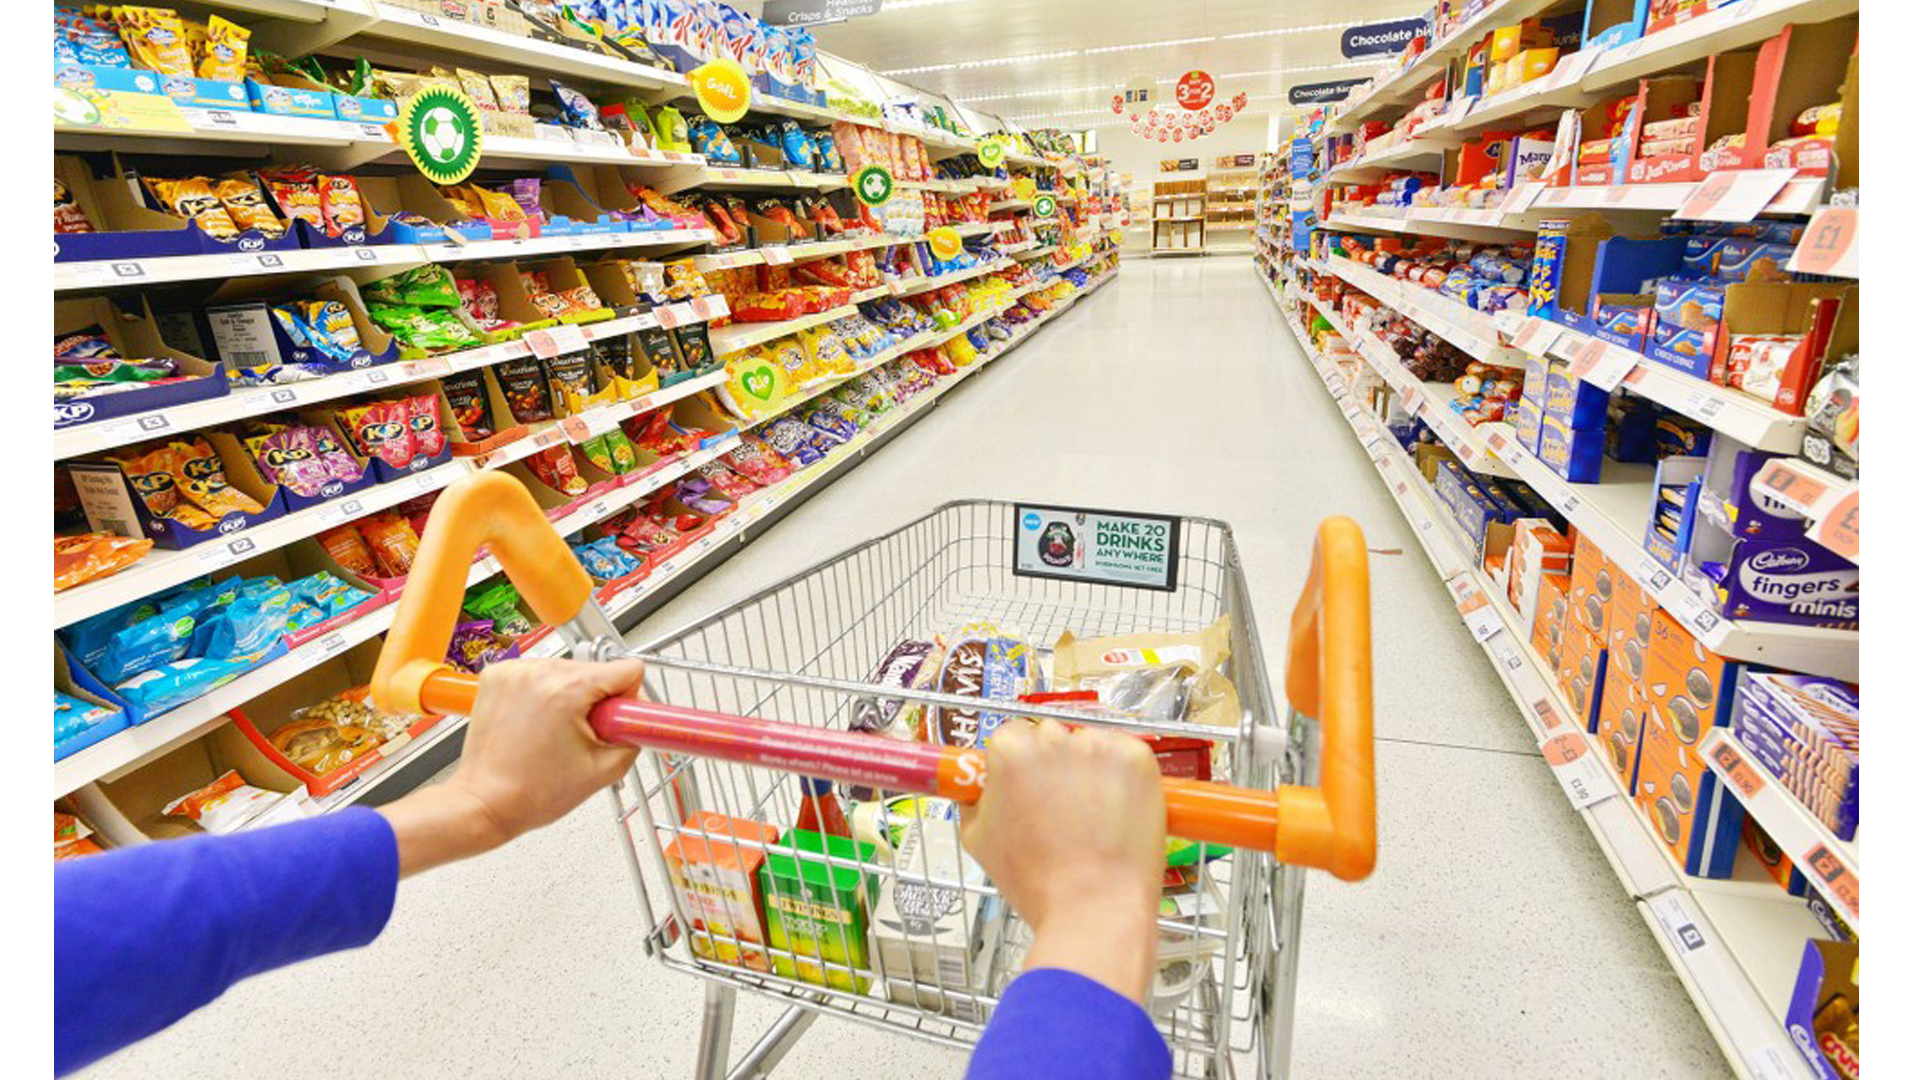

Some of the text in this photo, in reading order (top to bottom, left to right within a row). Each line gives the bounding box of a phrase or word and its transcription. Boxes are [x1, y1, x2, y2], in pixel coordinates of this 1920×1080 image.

[788, 4, 873, 22] Crisps & Snacks
[1350, 31, 1411, 48] Chocolate
[1178, 84, 1190, 101] 3
[1201, 82, 1213, 100] 2
[1294, 87, 1335, 99] Chocolate
[54, 401, 92, 422] KP
[368, 423, 403, 440] KP
[273, 450, 308, 463] KP
[136, 474, 171, 490] KP
[1097, 520, 1165, 537] MAKE 20
[1097, 532, 1165, 552] DRINKS
[1096, 548, 1164, 563] ANYWHERE
[1752, 551, 1806, 570] Cadbury
[1752, 575, 1840, 600] fingers
[1789, 598, 1858, 619] minis
